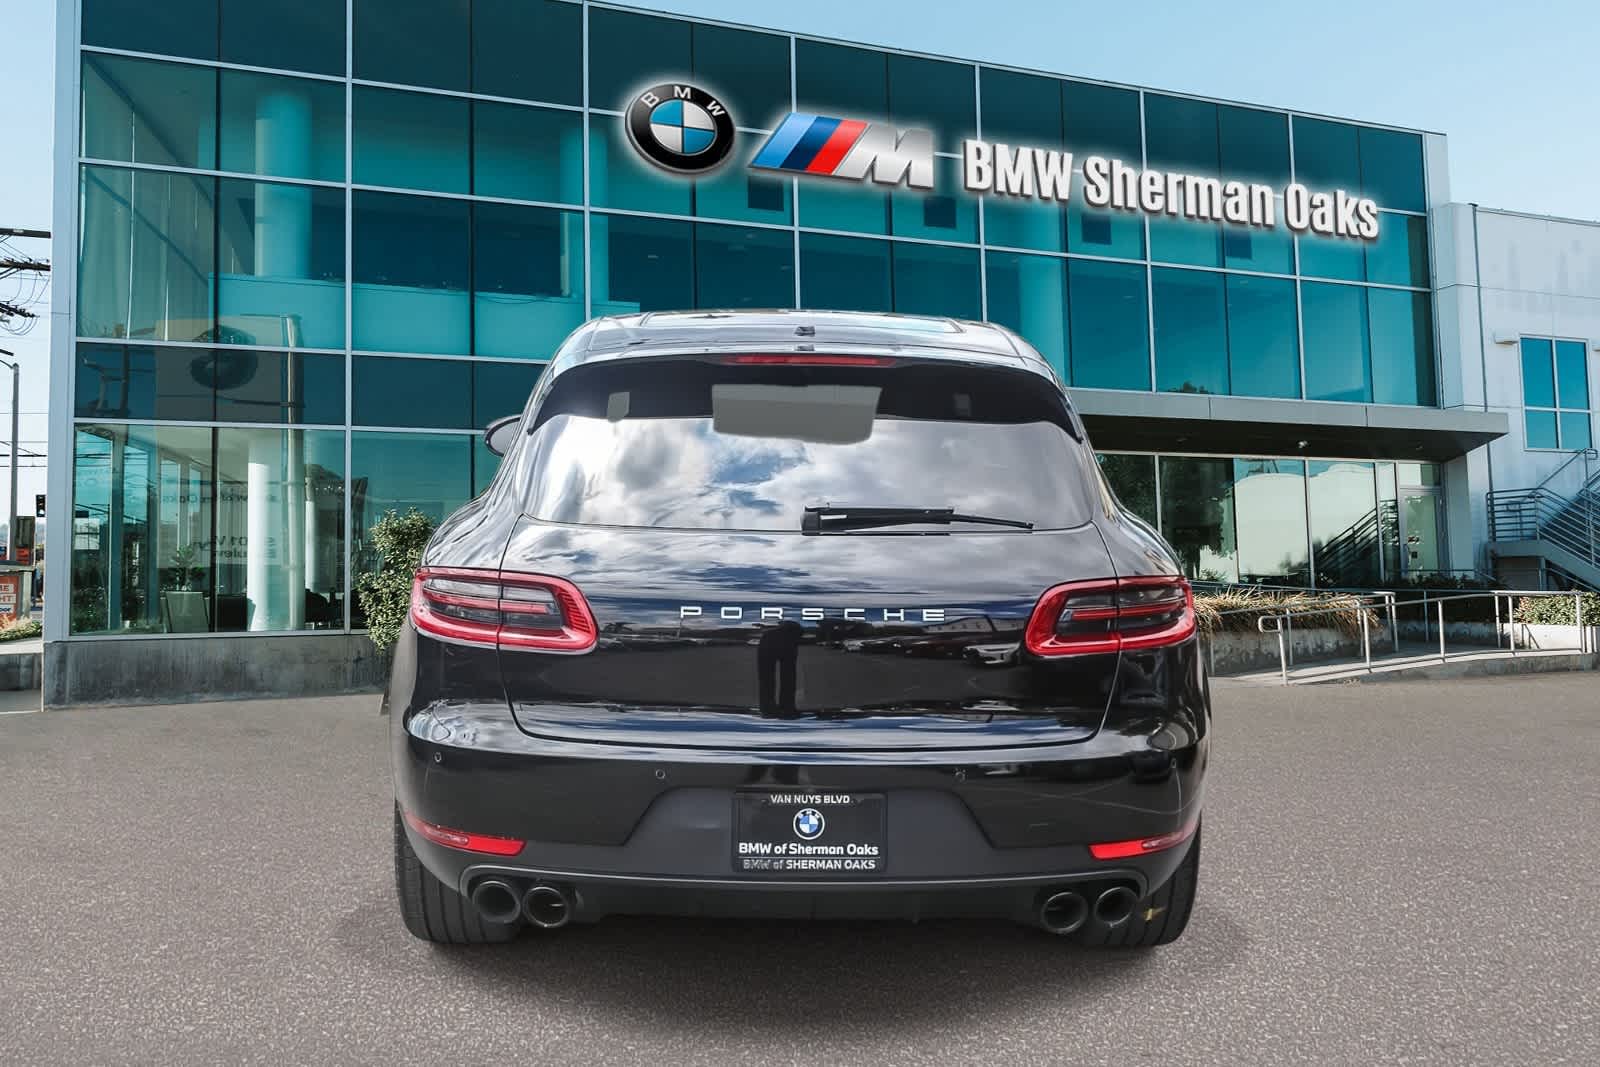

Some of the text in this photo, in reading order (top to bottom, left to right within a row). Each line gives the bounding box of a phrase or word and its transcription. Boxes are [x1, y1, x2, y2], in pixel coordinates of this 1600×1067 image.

[641, 85, 726, 117] BMW
[963, 139, 1379, 240] BMW Sherman Oaks
[680, 606, 945, 621] PORSCHE
[770, 794, 792, 804] VAN
[794, 794, 821, 804] NUYS
[738, 842, 879, 855] BMW of Sherman Oaks
[786, 859, 842, 870] SHERMAN
[844, 859, 876, 870] OAKS
